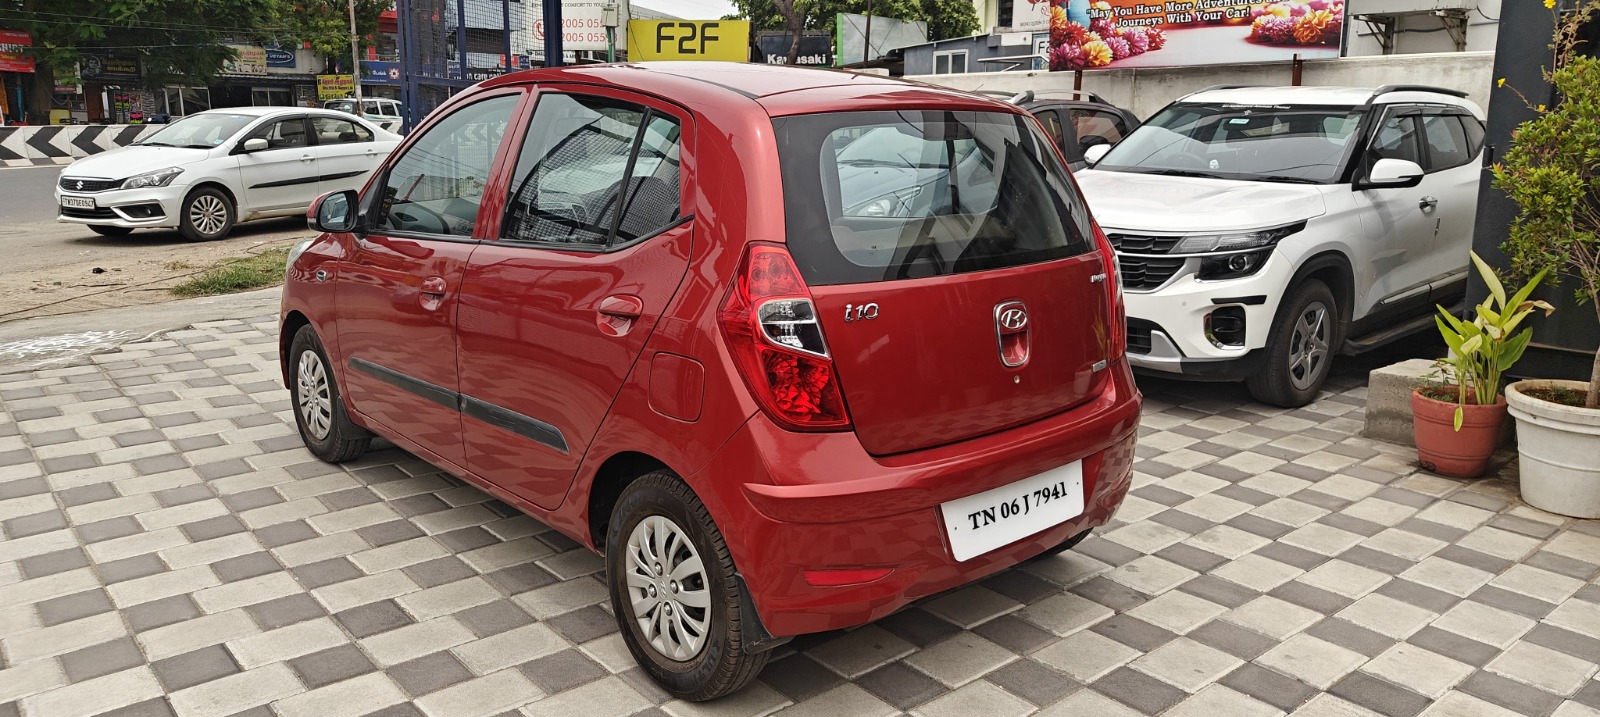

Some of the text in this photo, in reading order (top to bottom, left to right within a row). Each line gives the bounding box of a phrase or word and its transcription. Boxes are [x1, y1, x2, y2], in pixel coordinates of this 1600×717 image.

[1113, 7, 1134, 17] You
[1135, 3, 1161, 15] Have
[1165, 1, 1192, 13] More
[1116, 7, 1250, 28] Journeys With Your Car!
[656, 22, 720, 54] F2F
[844, 302, 880, 322] i10
[967, 481, 1068, 530] TN 06 J 7941
